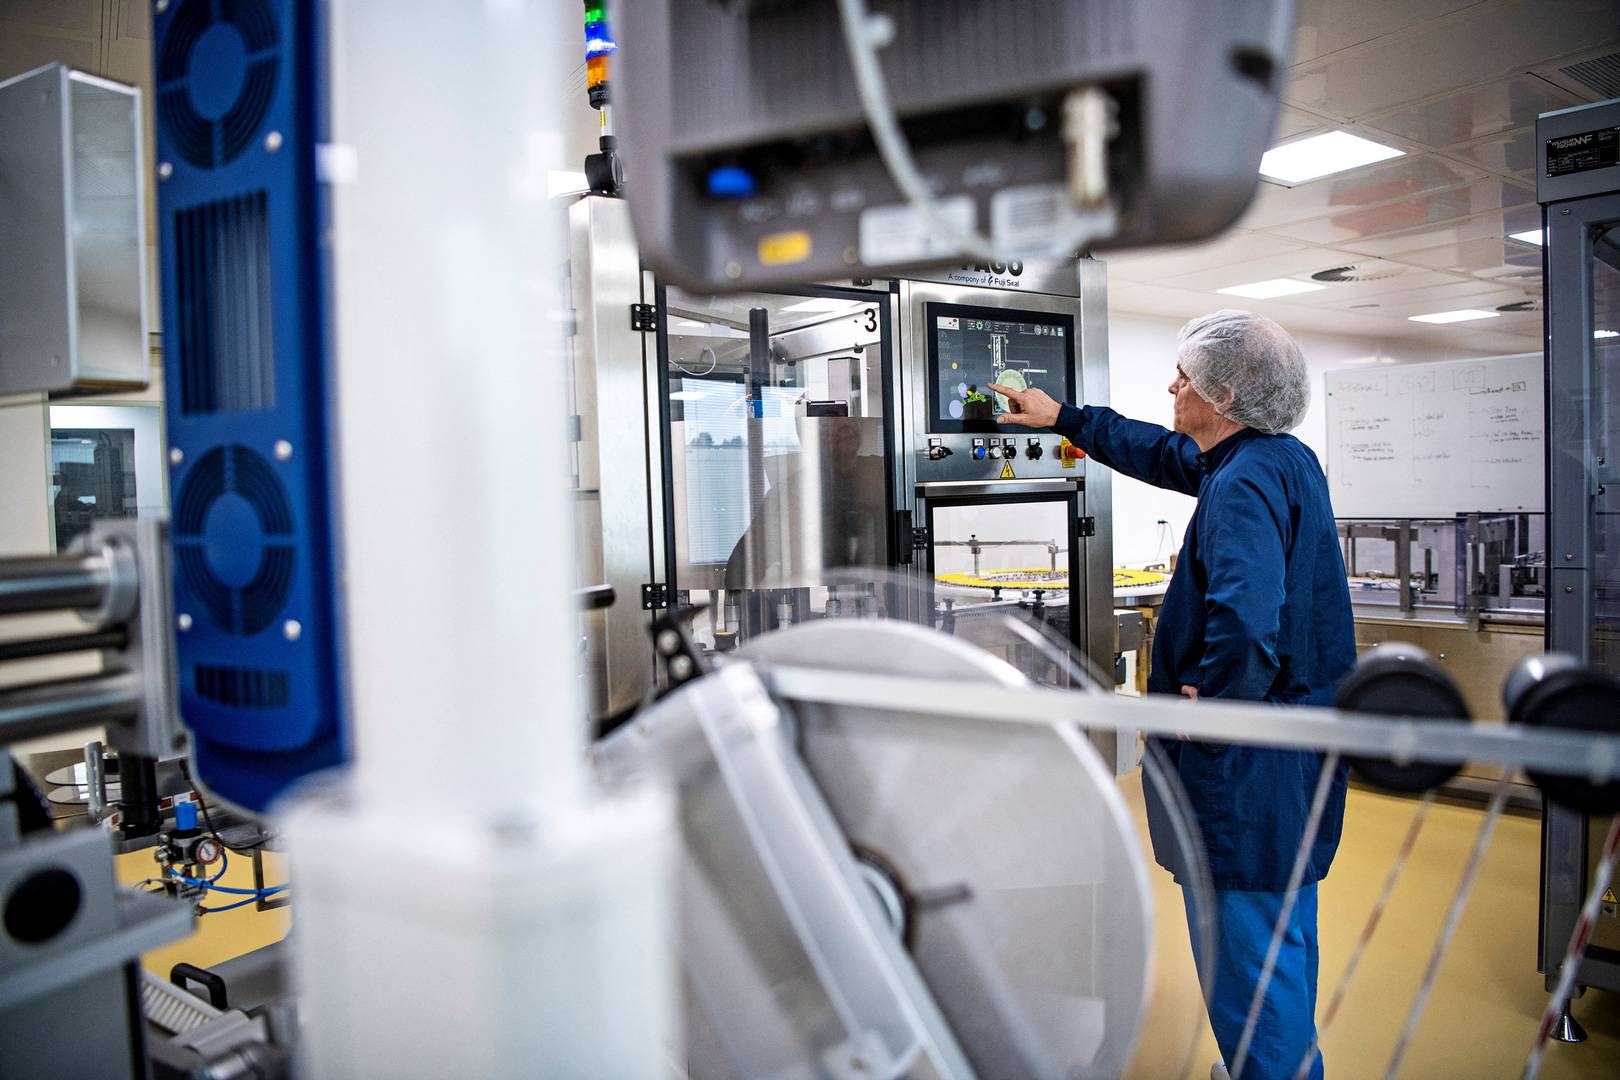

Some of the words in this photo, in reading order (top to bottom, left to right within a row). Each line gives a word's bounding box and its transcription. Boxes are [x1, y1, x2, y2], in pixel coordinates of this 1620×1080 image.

[947, 273, 954, 281] A
[954, 274, 979, 284] company
[980, 276, 987, 284] of
[994, 277, 1006, 287] Fuji
[1006, 279, 1020, 287] Seal
[864, 307, 877, 333] 3
